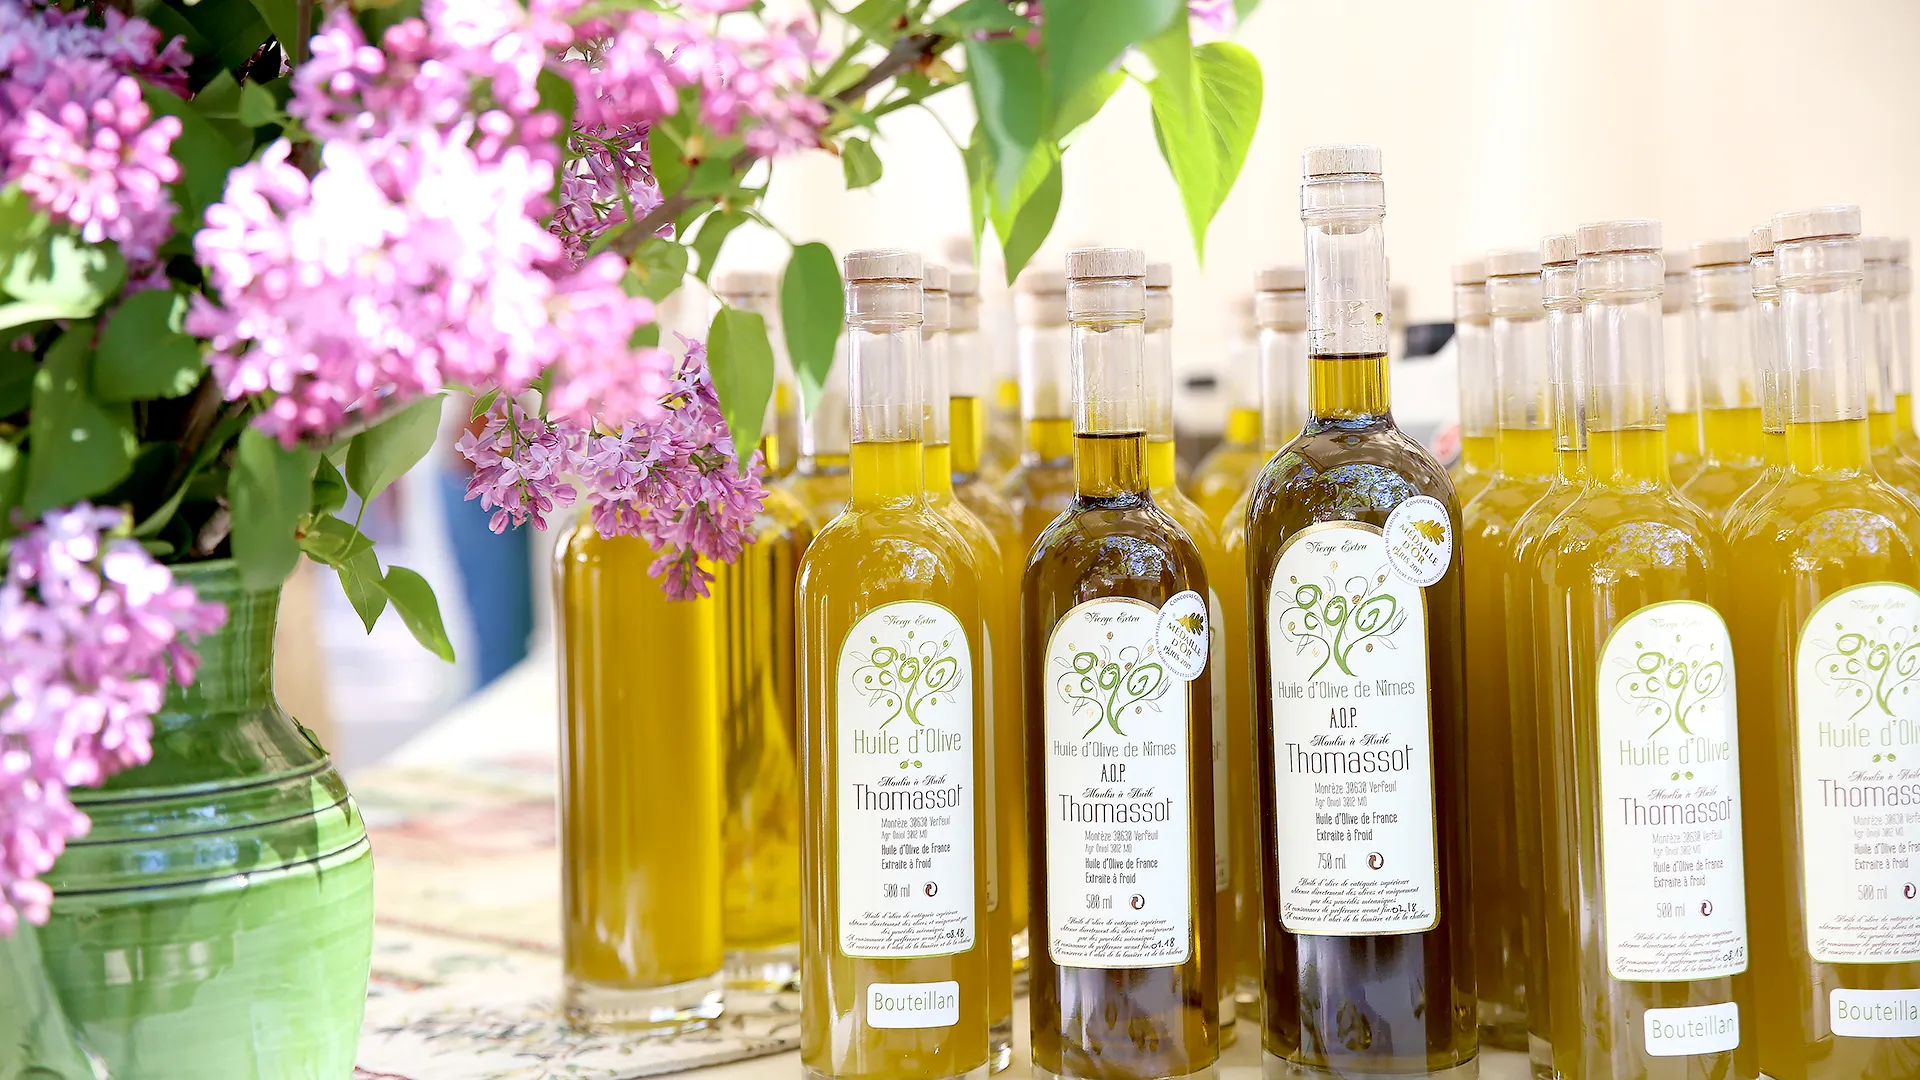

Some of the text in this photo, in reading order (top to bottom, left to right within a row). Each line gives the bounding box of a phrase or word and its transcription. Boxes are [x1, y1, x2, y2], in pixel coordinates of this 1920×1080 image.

[1305, 540, 1367, 556] Vierge Extra
[1400, 524, 1438, 566] MÉDAILLE
[1402, 541, 1425, 565] D'OR
[1392, 546, 1423, 576] PARIS 2017
[883, 613, 937, 628] Vierge Extra
[1084, 612, 1140, 626] Vierge Extra
[1180, 659, 1192, 670] 2017
[1278, 679, 1415, 699] Huile d'Olive de Nîmes
[1329, 707, 1357, 729] A.O.P.
[1310, 732, 1392, 747] Moulin à Huile
[1819, 719, 1920, 748] Huile d'Oli
[854, 728, 962, 755] Huile d'Olive
[1053, 741, 1176, 757] Huile d'Olive de Nîmes
[1285, 743, 1413, 774] Thomassot
[1619, 737, 1730, 766] Huile d'Olive
[1100, 763, 1126, 783] A.O.P.
[878, 776, 911, 788] Moulin
[922, 774, 947, 787] Huile
[1314, 782, 1343, 794] Montèze
[1345, 781, 1367, 794] 30630
[852, 784, 963, 811] Thomassot
[1082, 787, 1155, 799] Moulin à Huile
[1647, 788, 1682, 801] Moulin
[1818, 779, 1920, 807] Thomass
[1059, 794, 1173, 823] Thomassot
[1618, 796, 1733, 826] Thomassot
[881, 818, 908, 829] Montèze
[1315, 811, 1398, 825] Huile d'Olive de France
[1085, 830, 1112, 841] Montèze
[1316, 828, 1373, 841] Extraite à froid
[881, 842, 951, 856] Huile d'Olive de France
[881, 858, 932, 870] Extraite à froid
[1085, 858, 1158, 870] Huile d'Olive de France
[1317, 852, 1346, 870] 750 ml
[1653, 861, 1670, 873] Huile
[1695, 860, 1703, 871] de
[1704, 859, 1724, 870] France
[1085, 872, 1136, 884] Extraite à froid
[1653, 875, 1706, 889] Extraite à froid
[883, 884, 911, 898] 500 ml
[1858, 885, 1874, 900] 500
[1086, 894, 1113, 909] 500 ml
[1656, 902, 1685, 918] 500 ml
[874, 991, 954, 1011] Bouteillan
[1838, 1000, 1918, 1020] Bouteilla
[1652, 1015, 1734, 1039] Bouteillan
